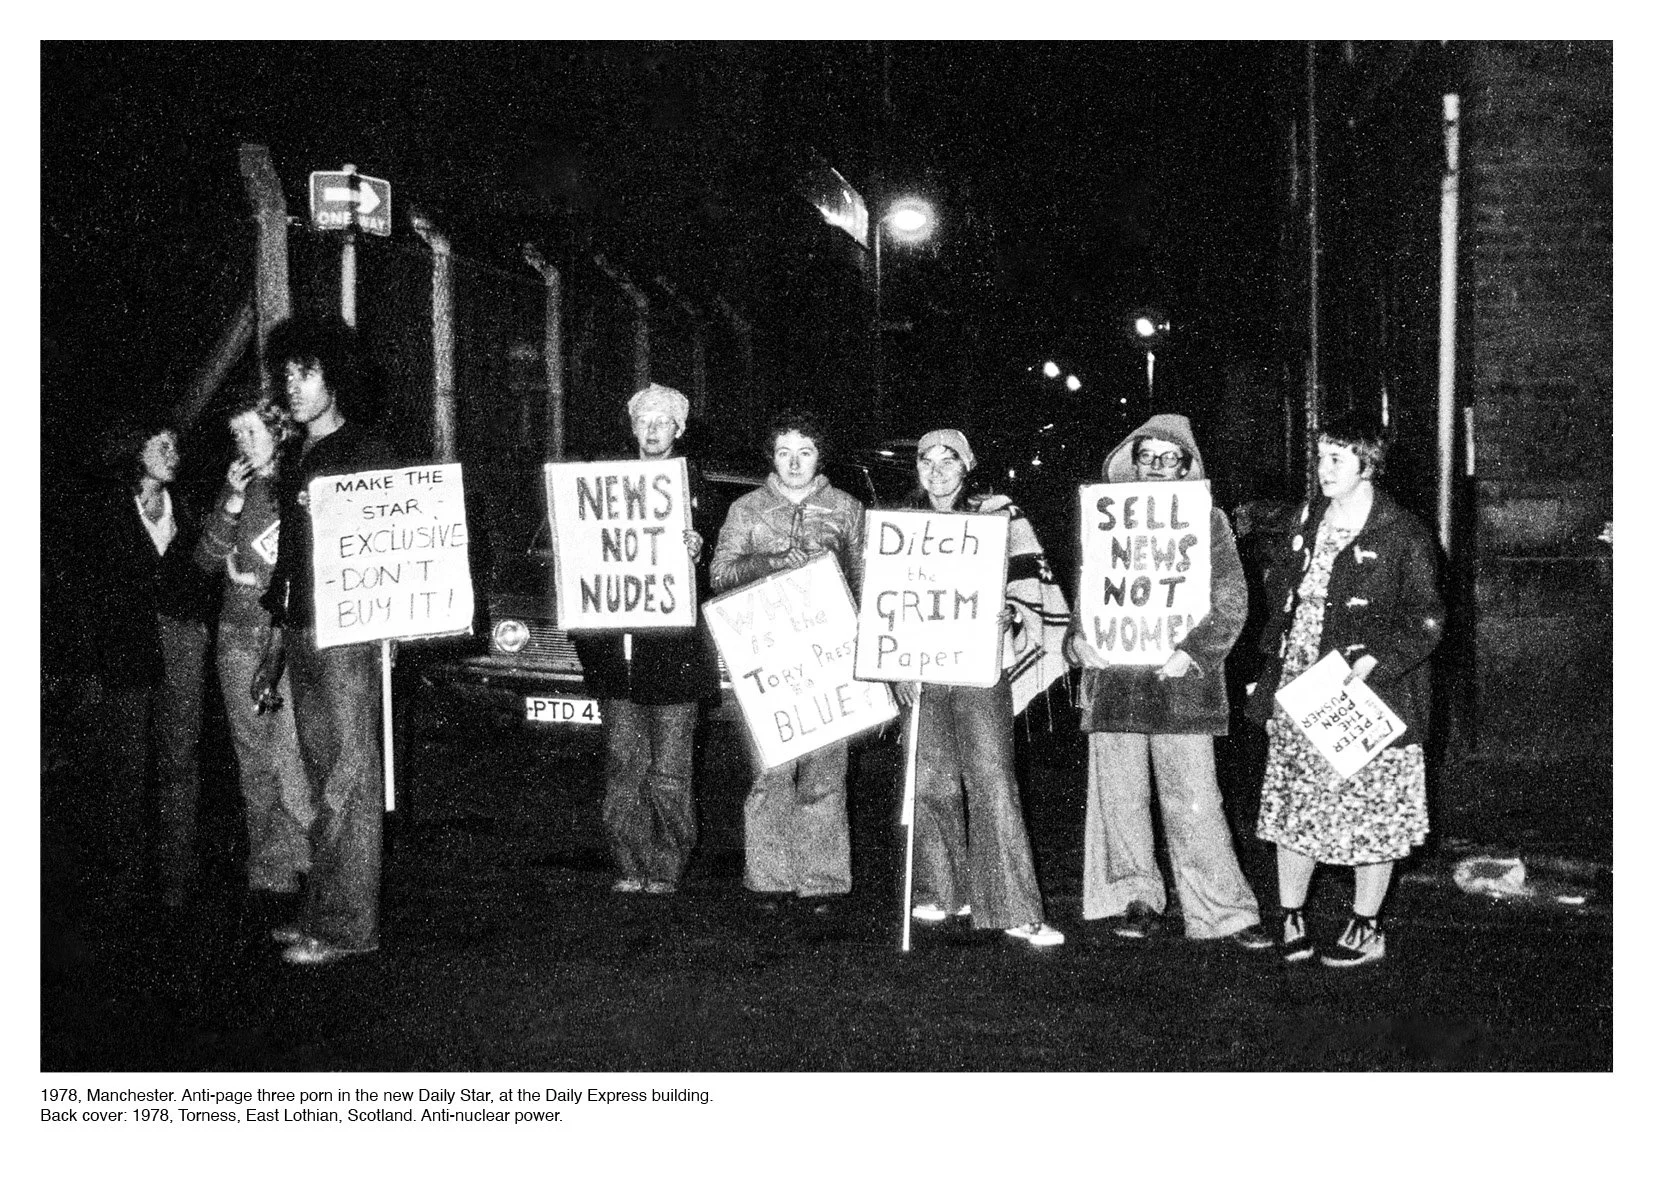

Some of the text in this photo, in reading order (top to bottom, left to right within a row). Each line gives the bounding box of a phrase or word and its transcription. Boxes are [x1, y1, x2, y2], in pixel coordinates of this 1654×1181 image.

[335, 471, 443, 492] MAKE THE
[576, 474, 672, 520] NEWS
[363, 499, 422, 519] STAR
[1096, 493, 1190, 531] SELL
[340, 524, 466, 558] EXCLUSIVE
[601, 526, 665, 566] NOT
[879, 520, 979, 556] Ditch
[1111, 534, 1198, 573] NEWS
[908, 566, 936, 582] the
[580, 573, 676, 614] NUDES
[715, 568, 812, 636] WHY
[1104, 575, 1186, 608] NOT
[338, 597, 391, 628] BUY
[790, 609, 828, 632] the
[877, 588, 979, 632] GRIM
[811, 637, 858, 667] PRES
[878, 635, 964, 676] Paper
[534, 700, 601, 721] PTD 4
[1301, 690, 1348, 728] PUSHER
[1321, 699, 1356, 730] PORN
[1338, 710, 1364, 733] THE
[1333, 718, 1373, 753] PETER
